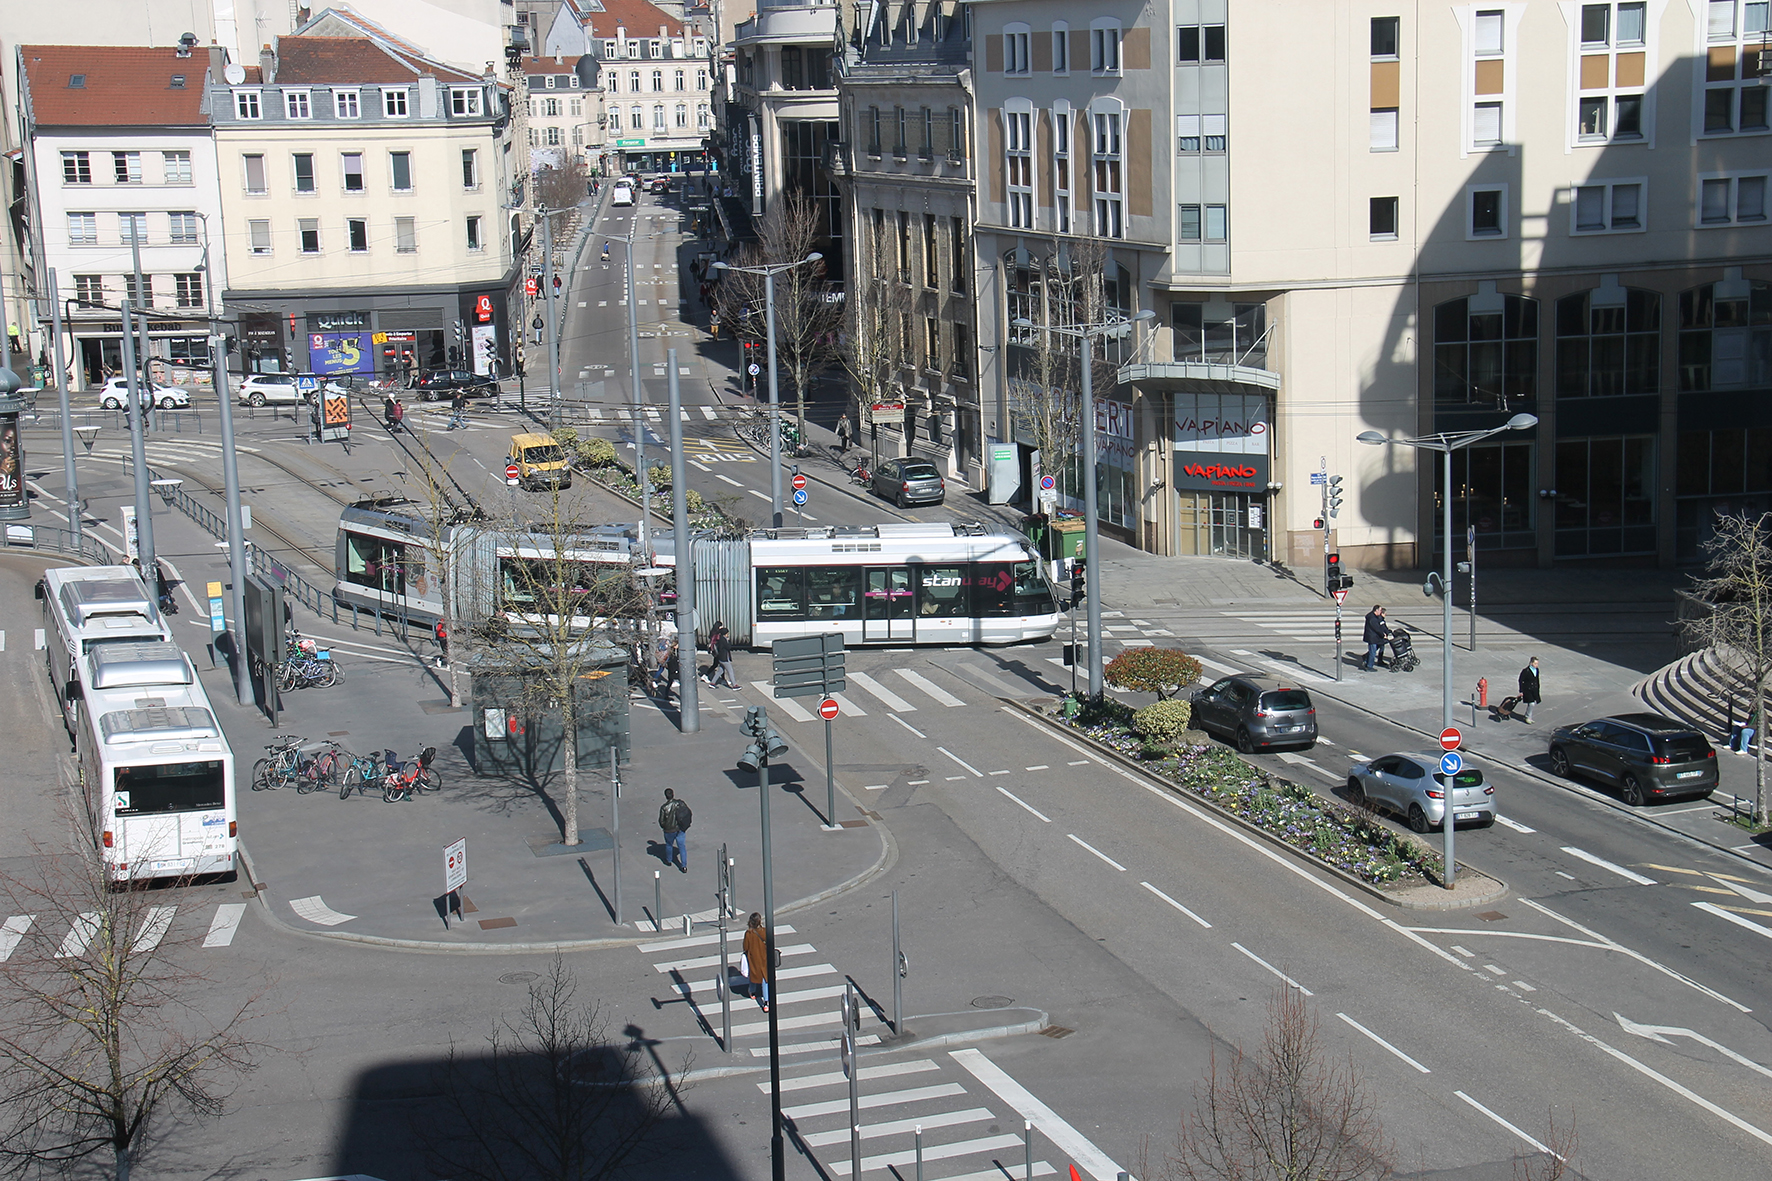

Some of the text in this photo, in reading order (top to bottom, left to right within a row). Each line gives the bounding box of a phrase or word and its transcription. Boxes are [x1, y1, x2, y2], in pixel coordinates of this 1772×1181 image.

[752, 134, 763, 197] PRINTEMPS
[481, 298, 491, 310] Q
[148, 322, 182, 331] kebab
[318, 313, 363, 329] Quick
[695, 453, 757, 462] BUS
